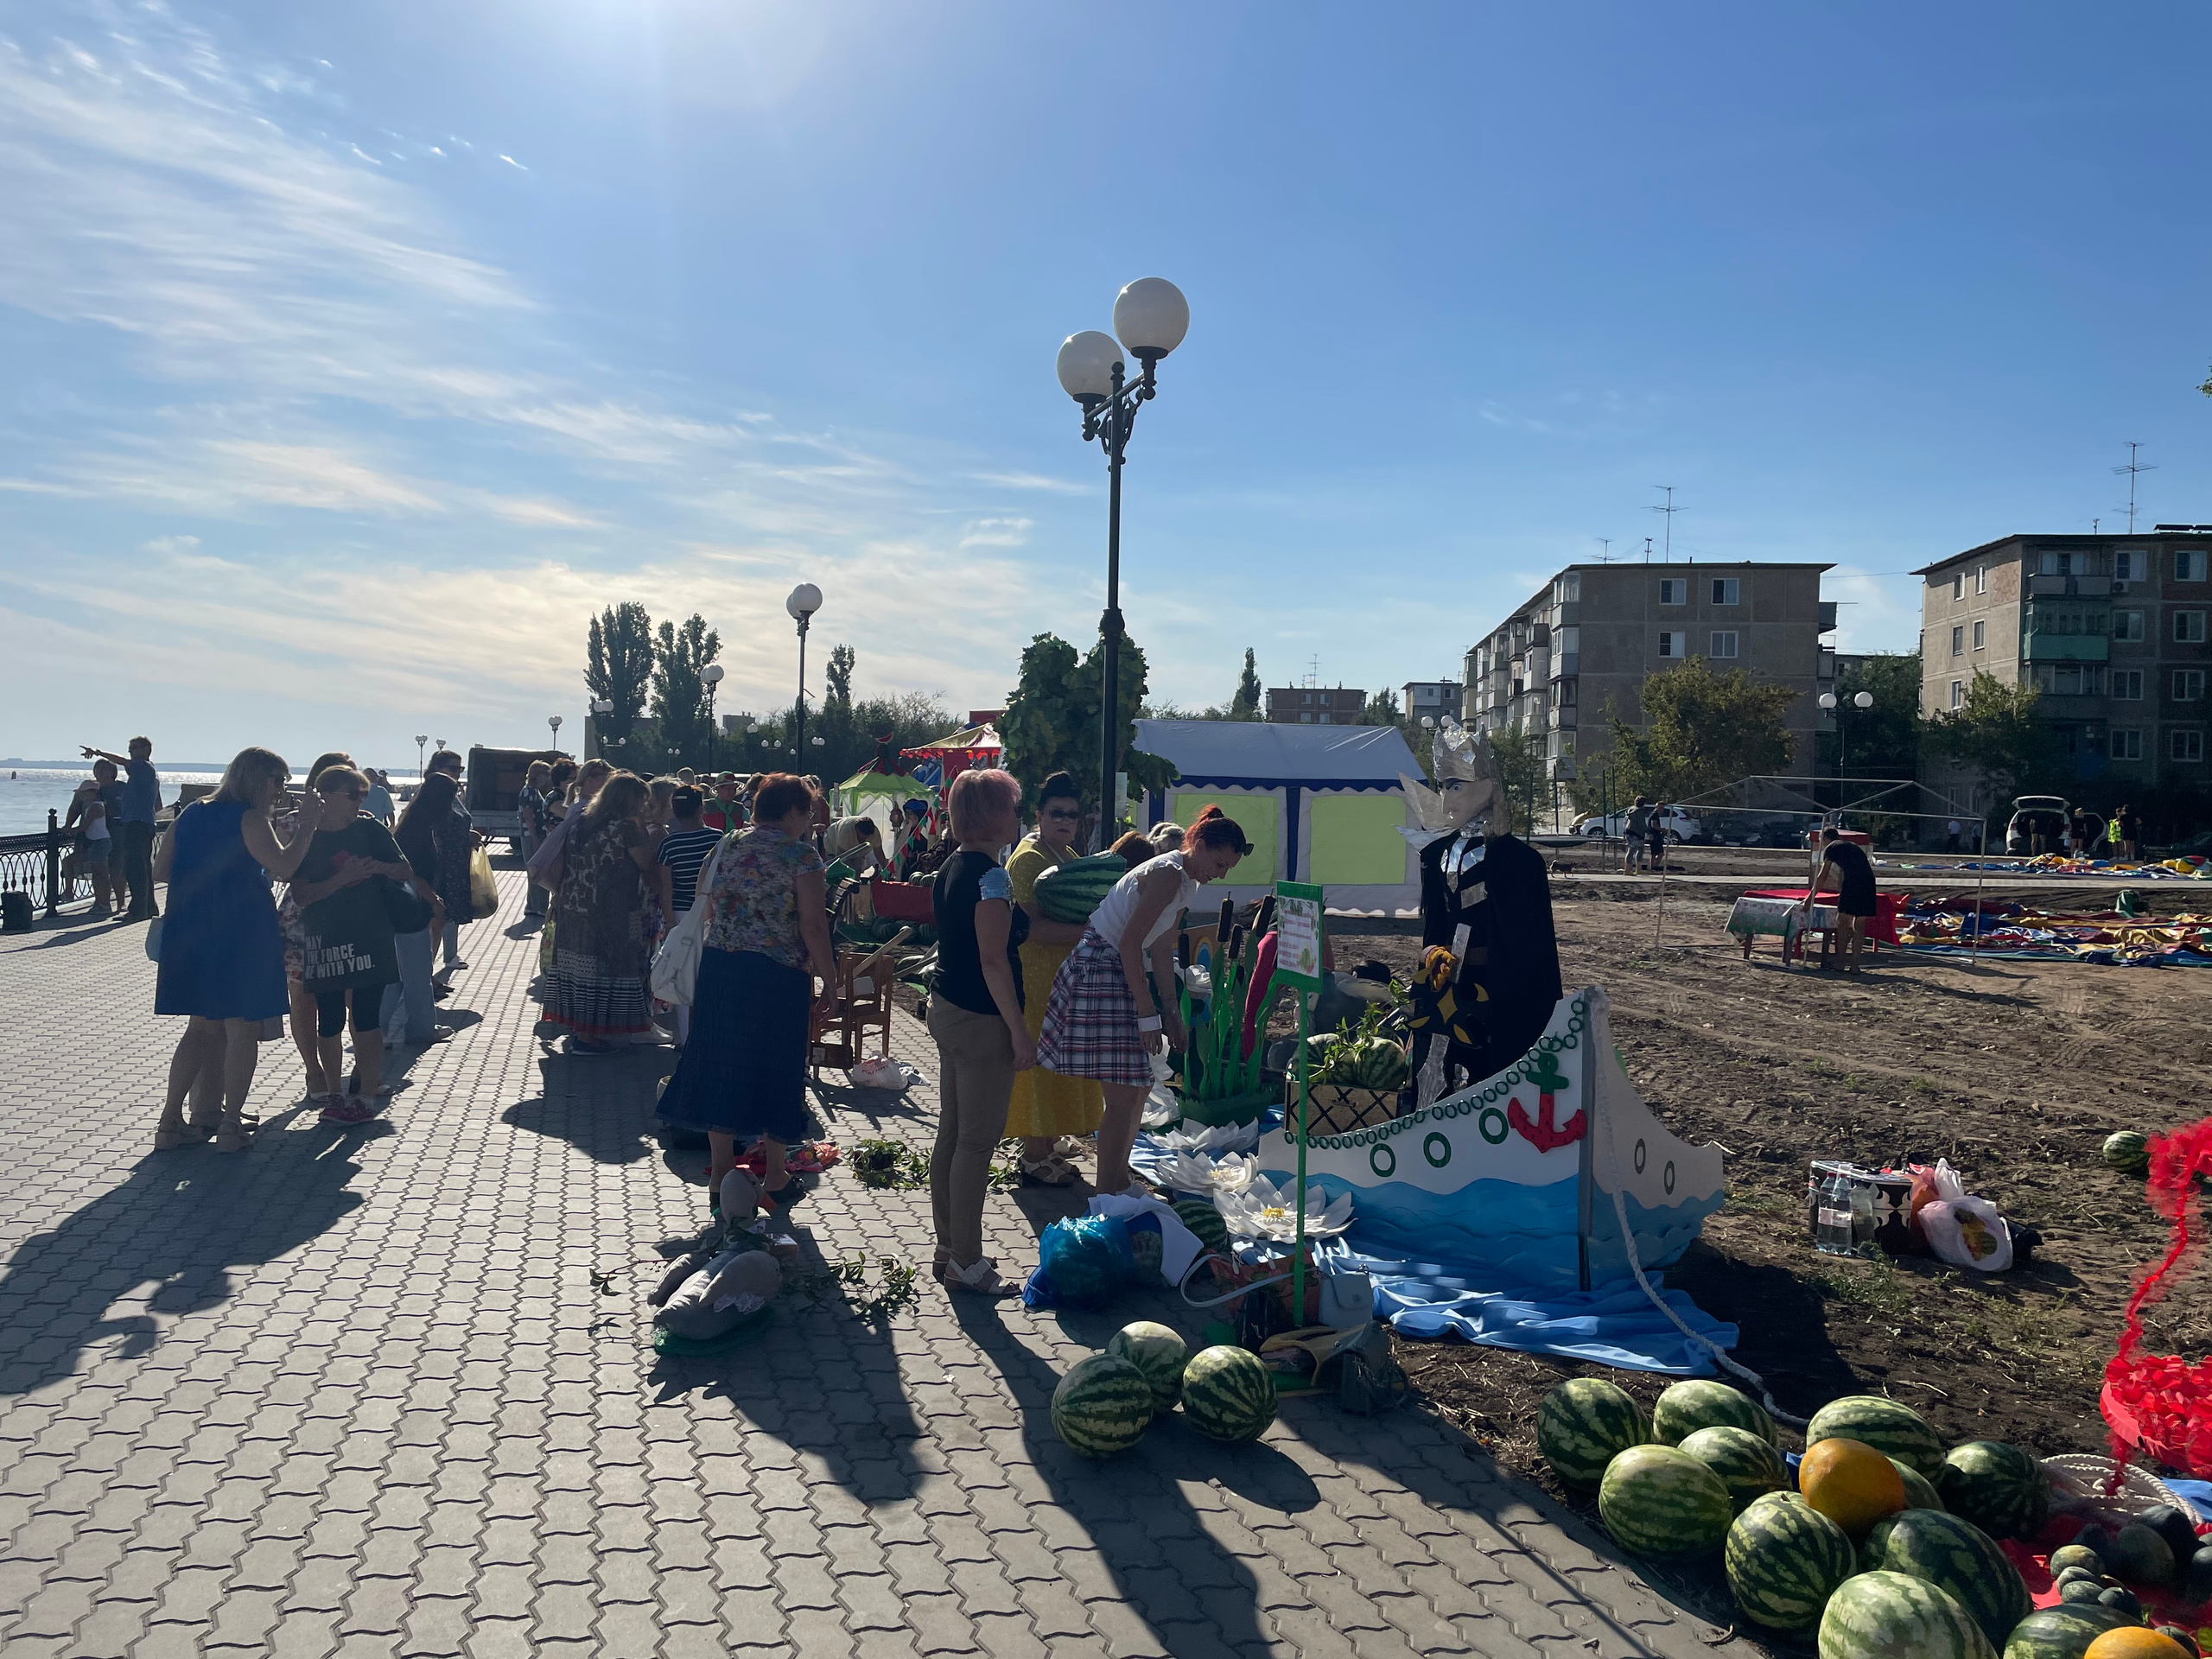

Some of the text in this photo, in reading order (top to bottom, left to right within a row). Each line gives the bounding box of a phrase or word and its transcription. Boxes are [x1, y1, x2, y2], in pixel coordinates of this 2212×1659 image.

[305, 935, 322, 950] MAY
[306, 944, 355, 965] THE FORCE
[305, 955, 375, 980] BE WITH YOU.
